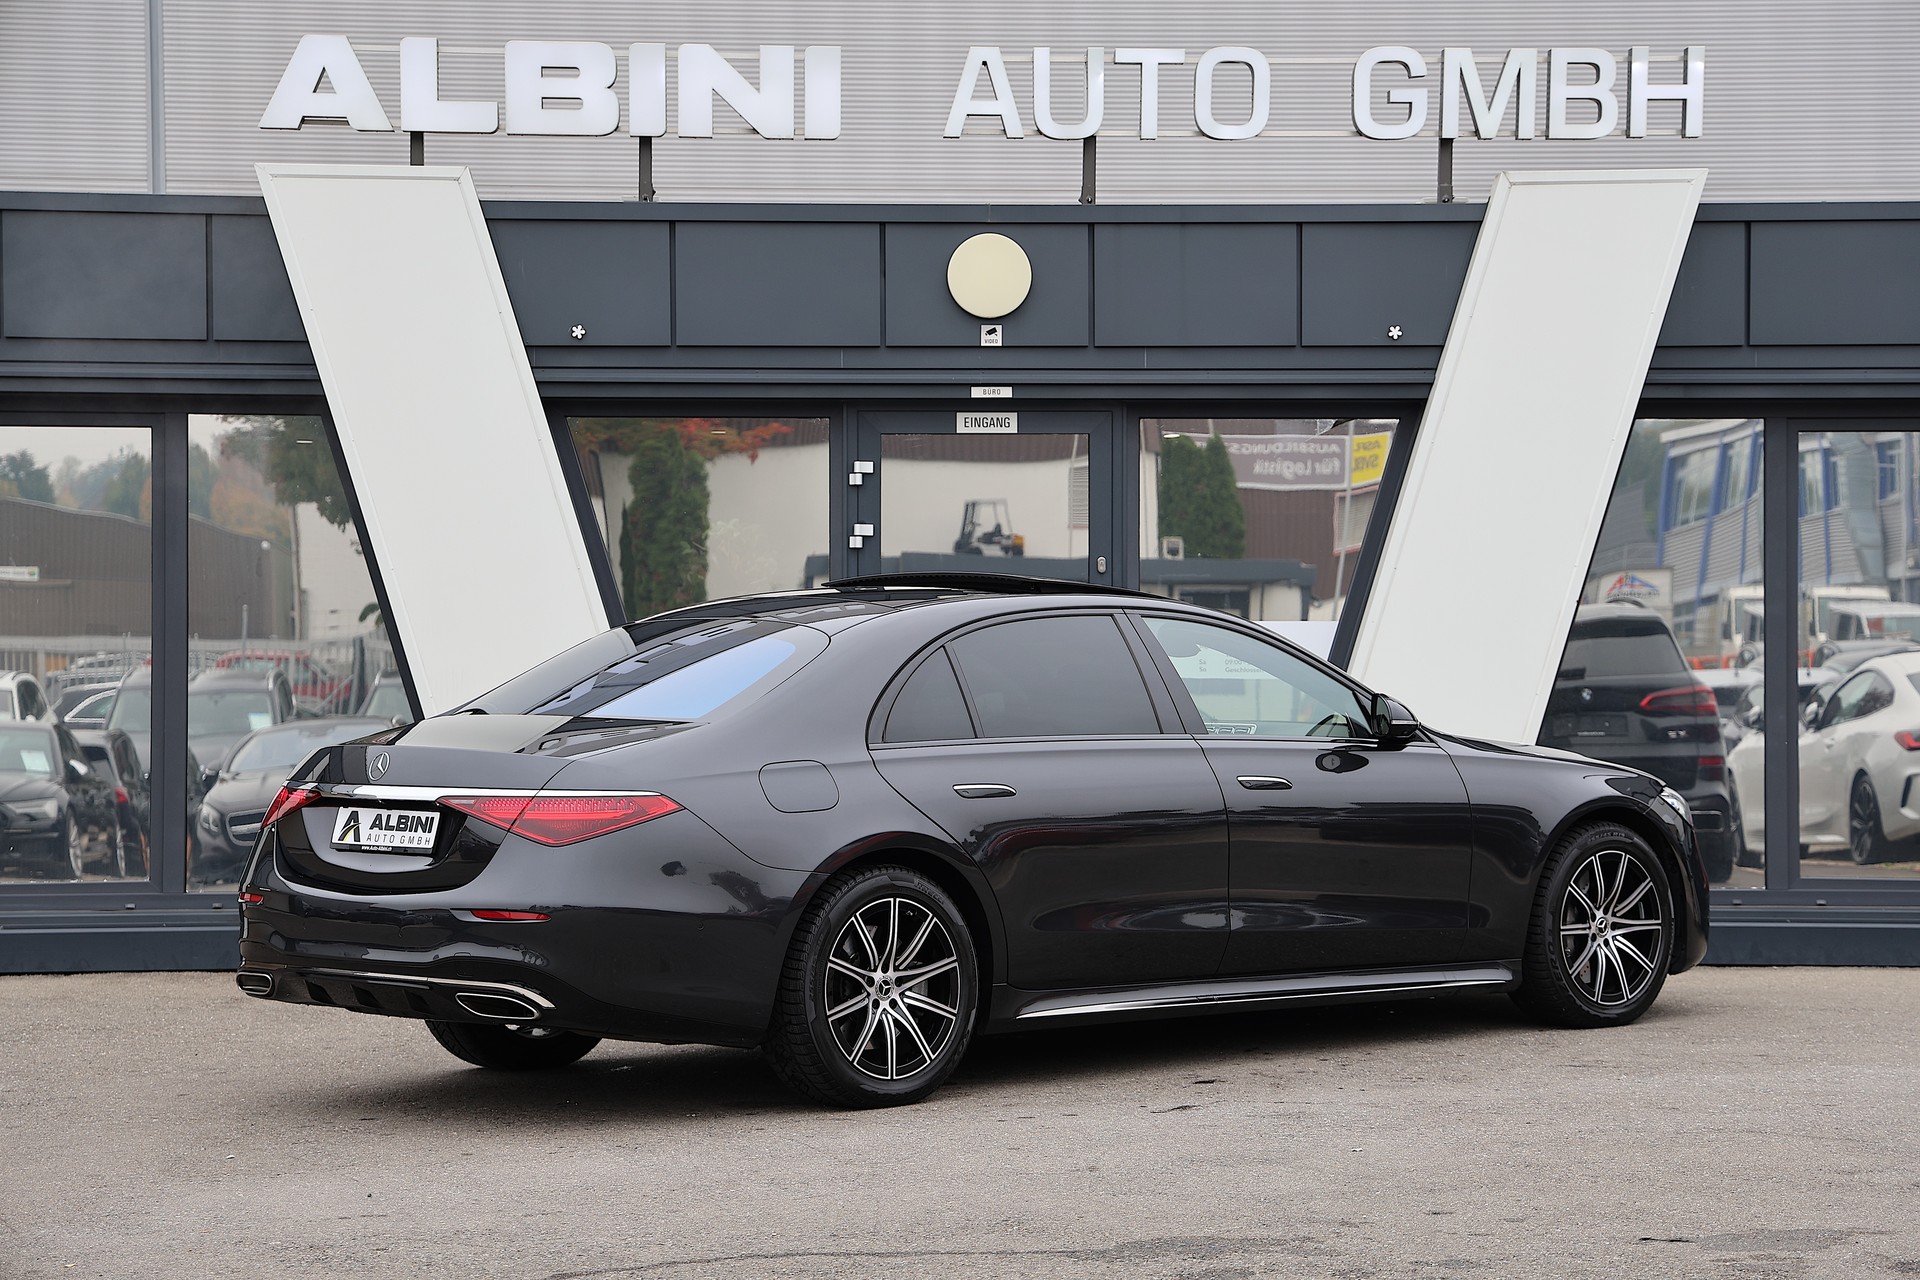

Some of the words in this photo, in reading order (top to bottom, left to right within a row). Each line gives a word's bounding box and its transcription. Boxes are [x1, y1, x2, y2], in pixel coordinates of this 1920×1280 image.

[258, 33, 842, 141] ALBINI
[942, 45, 1271, 141] AUTO
[1352, 45, 1705, 141] GMBH
[963, 416, 1011, 428] EINGANG
[368, 813, 435, 834] ALBINI
[366, 833, 396, 844] AUTO
[399, 835, 431, 846] GMBH
